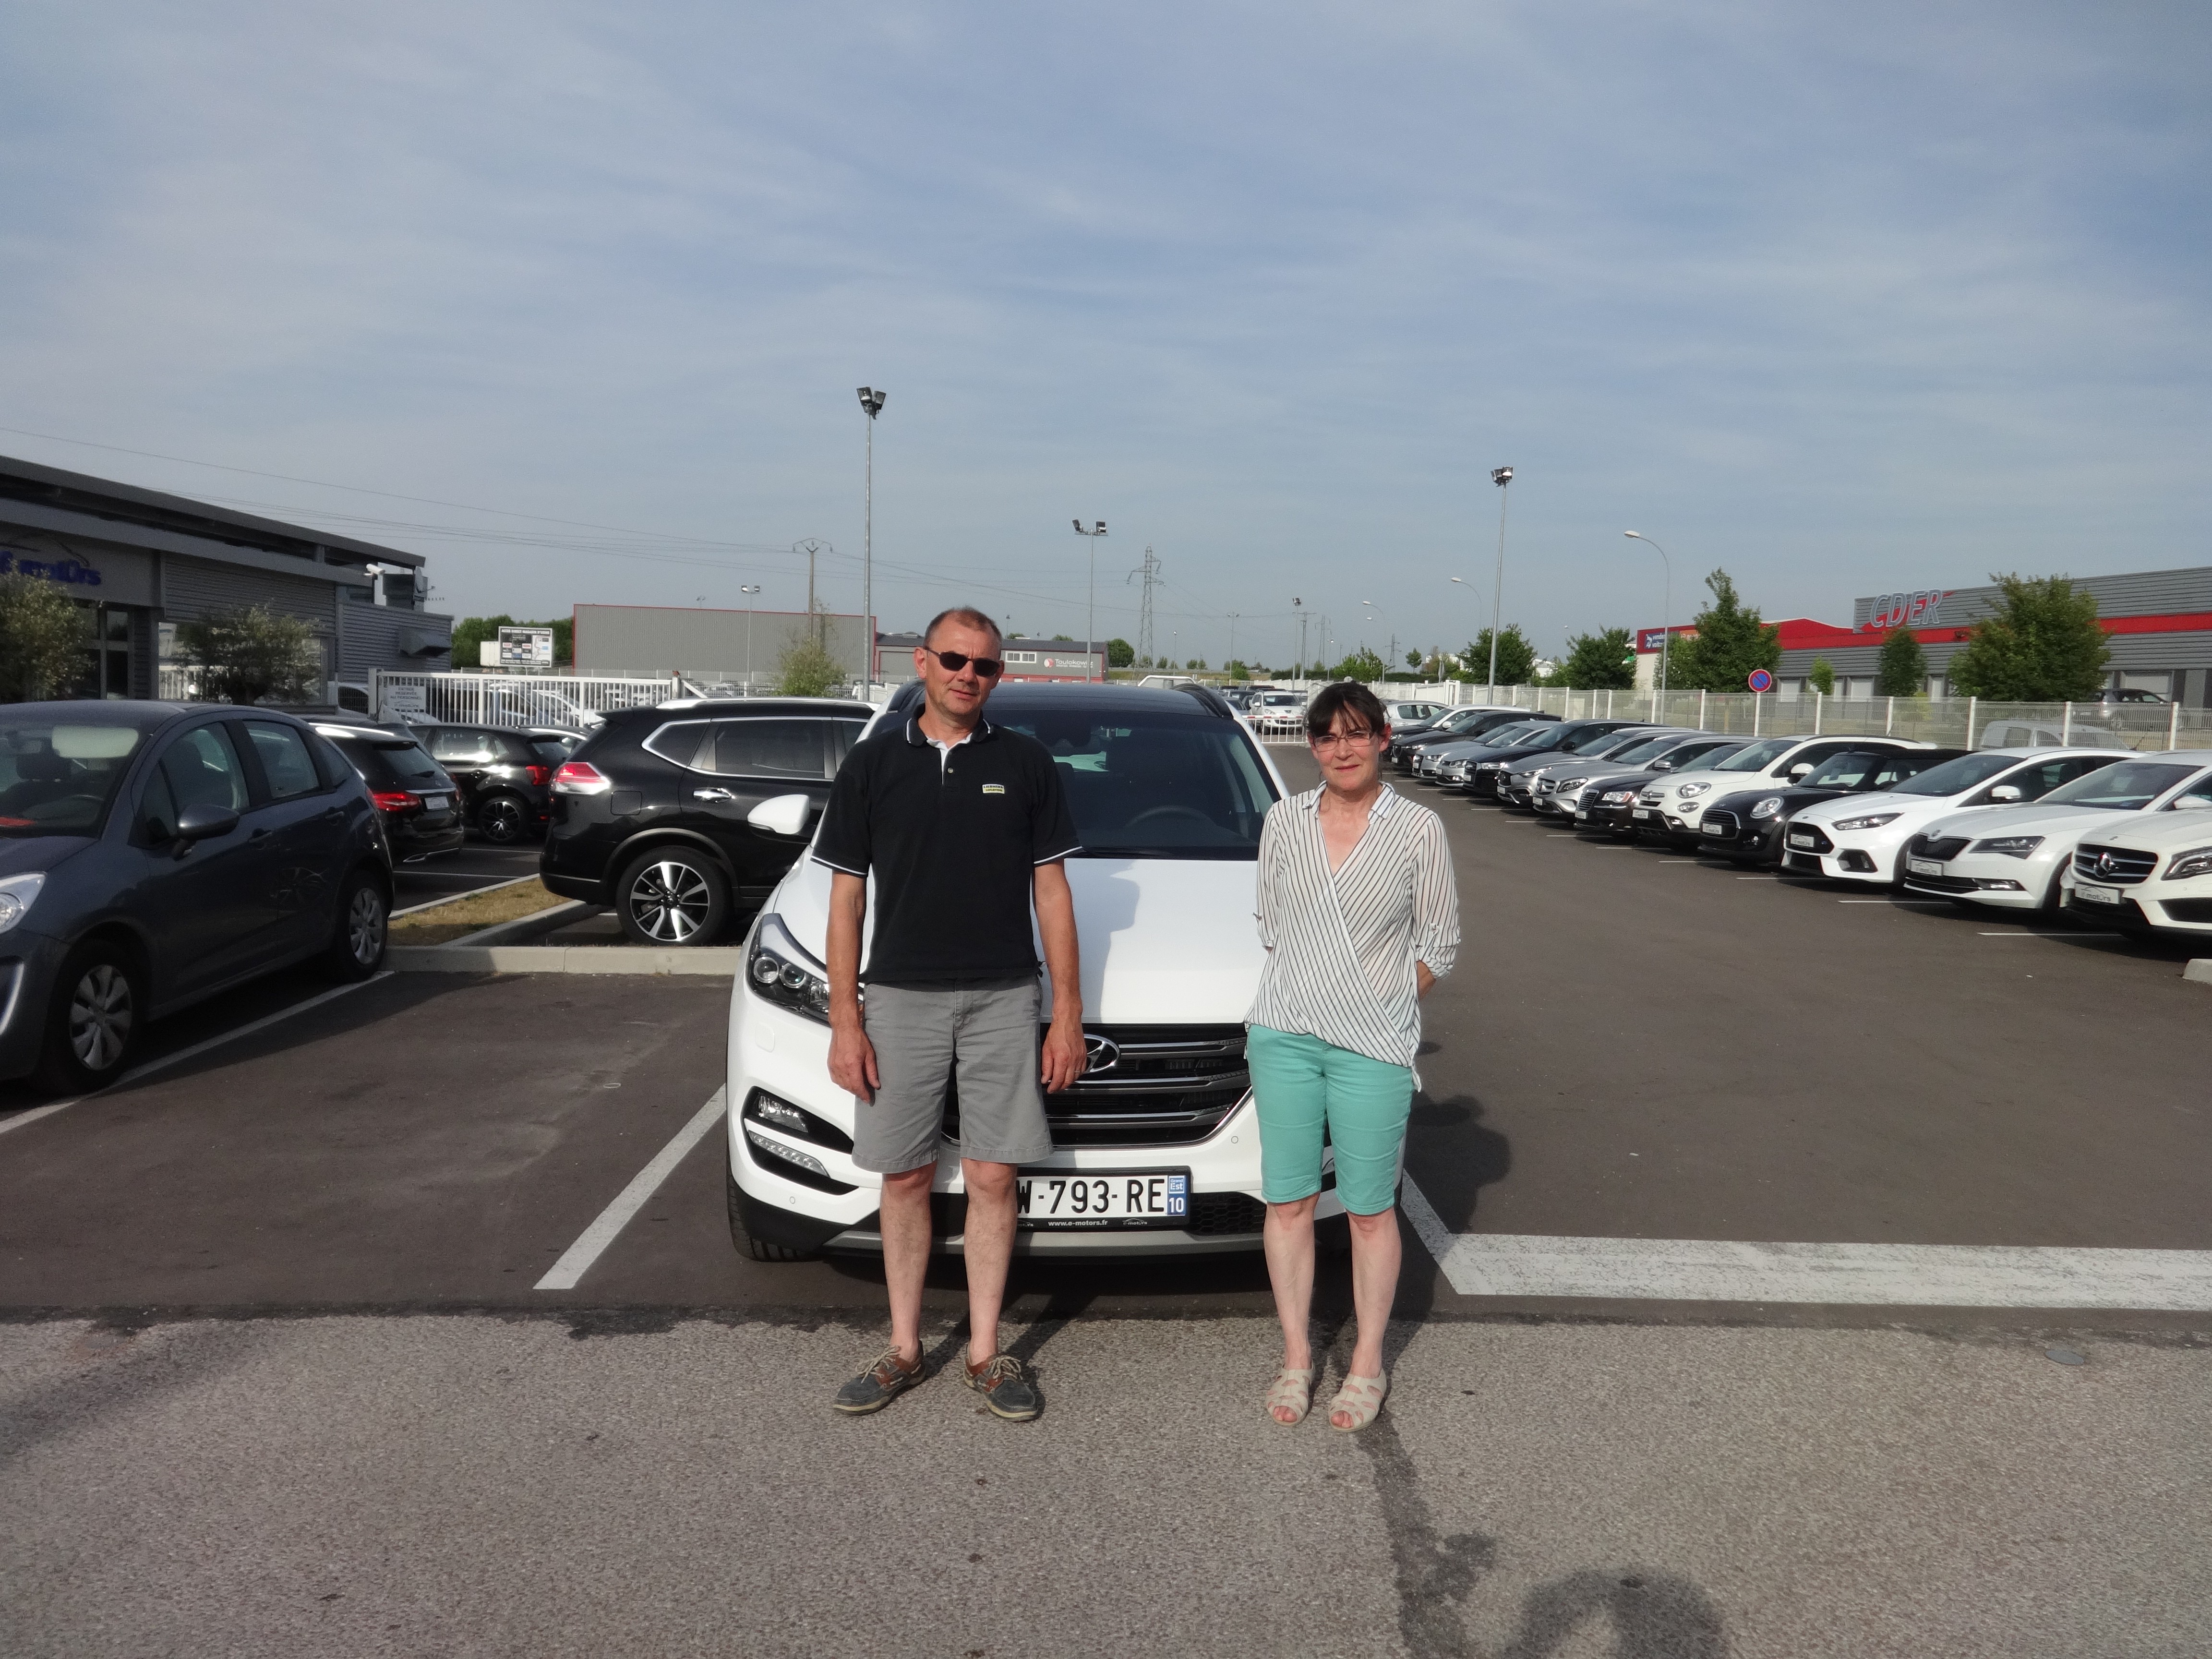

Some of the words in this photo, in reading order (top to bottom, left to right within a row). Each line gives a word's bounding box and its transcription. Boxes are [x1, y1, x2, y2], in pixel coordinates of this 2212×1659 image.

[1870, 589, 1943, 627] CDER
[1016, 1178, 1165, 1214] W-793-RE
[1169, 1197, 1184, 1213] 10
